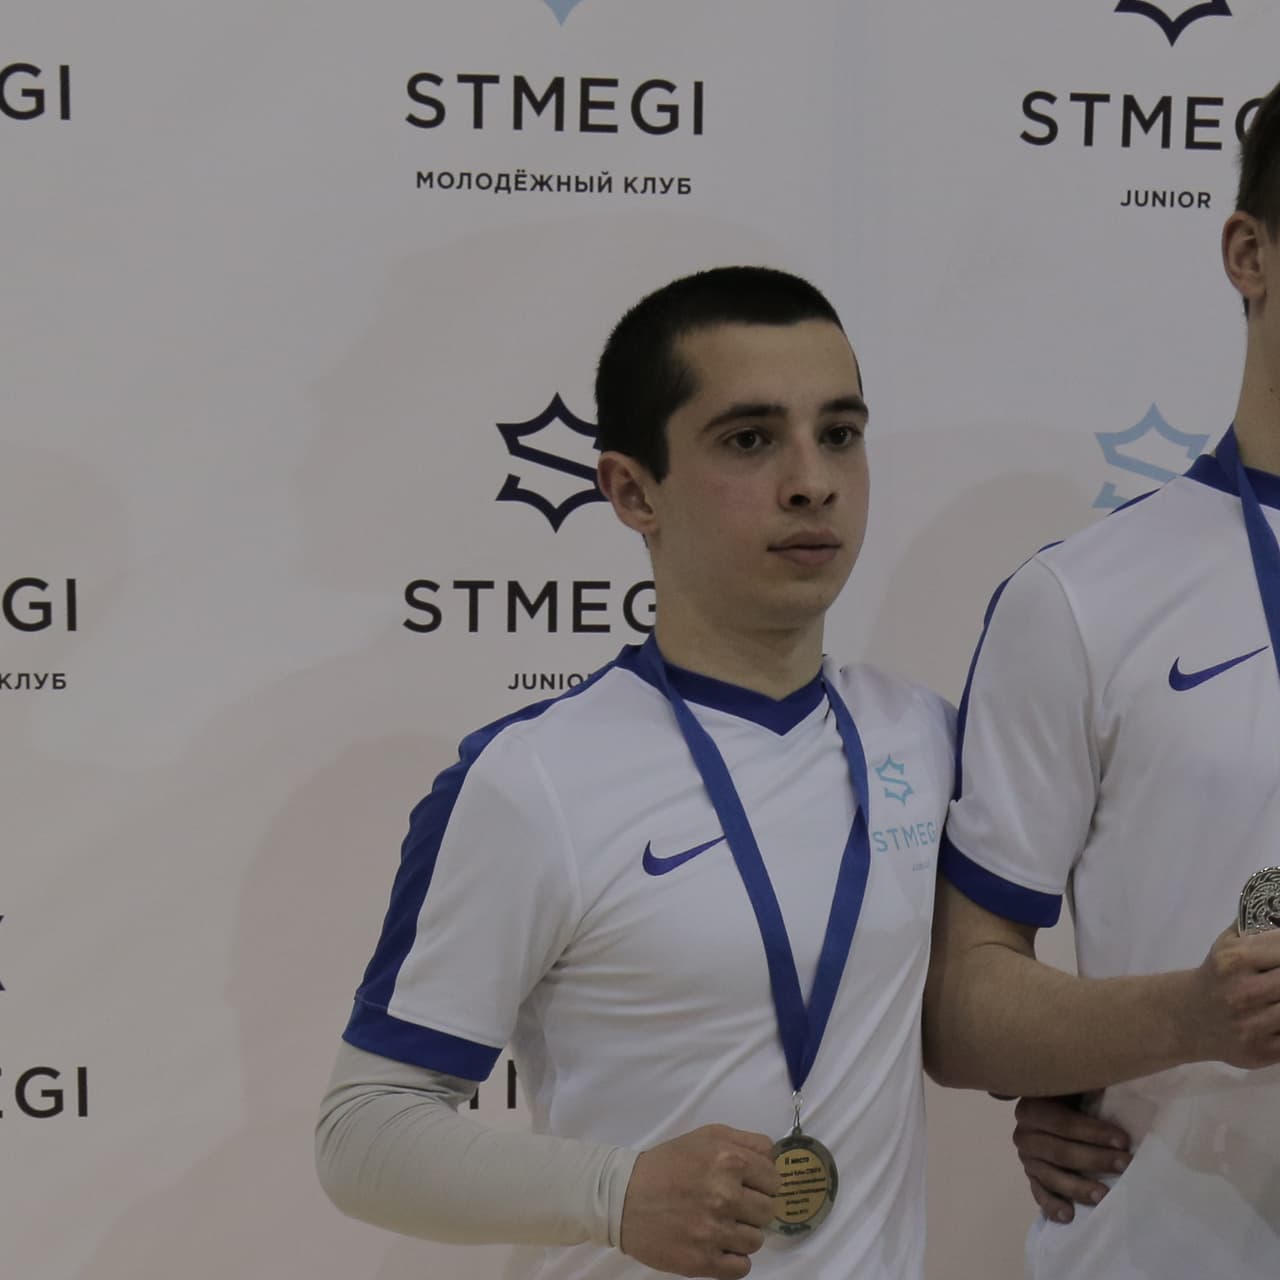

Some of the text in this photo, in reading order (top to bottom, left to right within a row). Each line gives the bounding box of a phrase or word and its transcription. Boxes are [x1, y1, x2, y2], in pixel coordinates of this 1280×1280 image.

[405, 72, 704, 136] STMEGI
[1019, 90, 1266, 151] STME
[416, 168, 692, 195] МОЛОДЁЖНЫЙ КЛУБ
[1120, 189, 1212, 209] JUNIOR
[402, 579, 656, 634] STMEG
[507, 673, 590, 690] JUNIO
[872, 821, 939, 853] STMEG
